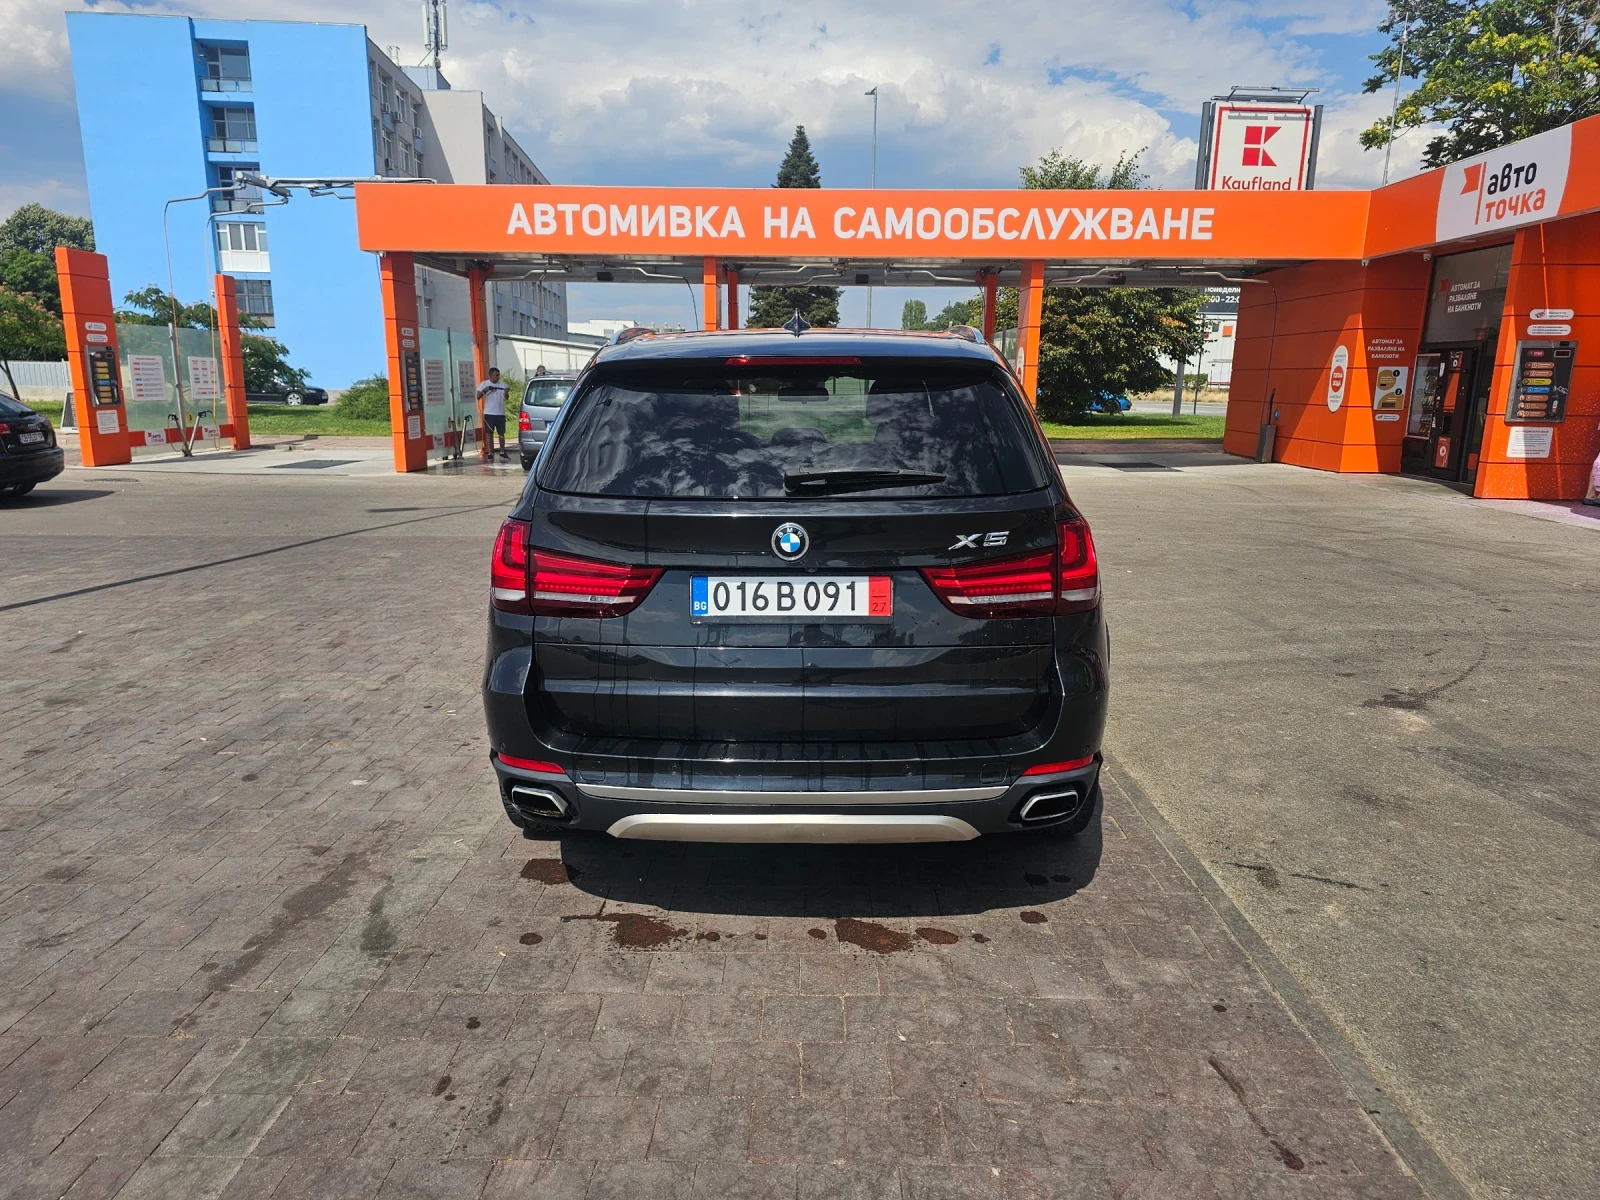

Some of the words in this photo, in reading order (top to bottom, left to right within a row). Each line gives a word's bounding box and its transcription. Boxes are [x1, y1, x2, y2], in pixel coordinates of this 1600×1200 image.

[1221, 175, 1292, 190] Kaufland
[1485, 188, 1546, 222] точка
[506, 202, 746, 238] АВТОМИВКА
[763, 206, 816, 239] НА
[833, 206, 1215, 241] САМООБСЛУЖВАНЕ
[1450, 282, 1473, 292] АВТОМАТ
[1473, 281, 1481, 289] ЗА
[1448, 292, 1477, 302] РАЗВАЛЯНЕ
[1454, 302, 1482, 312] БАНКНОТИ
[777, 527, 803, 538] BMW
[948, 530, 1010, 550] X5
[693, 601, 707, 611] BG
[713, 581, 856, 612] 016B091
[871, 601, 887, 613] 27
